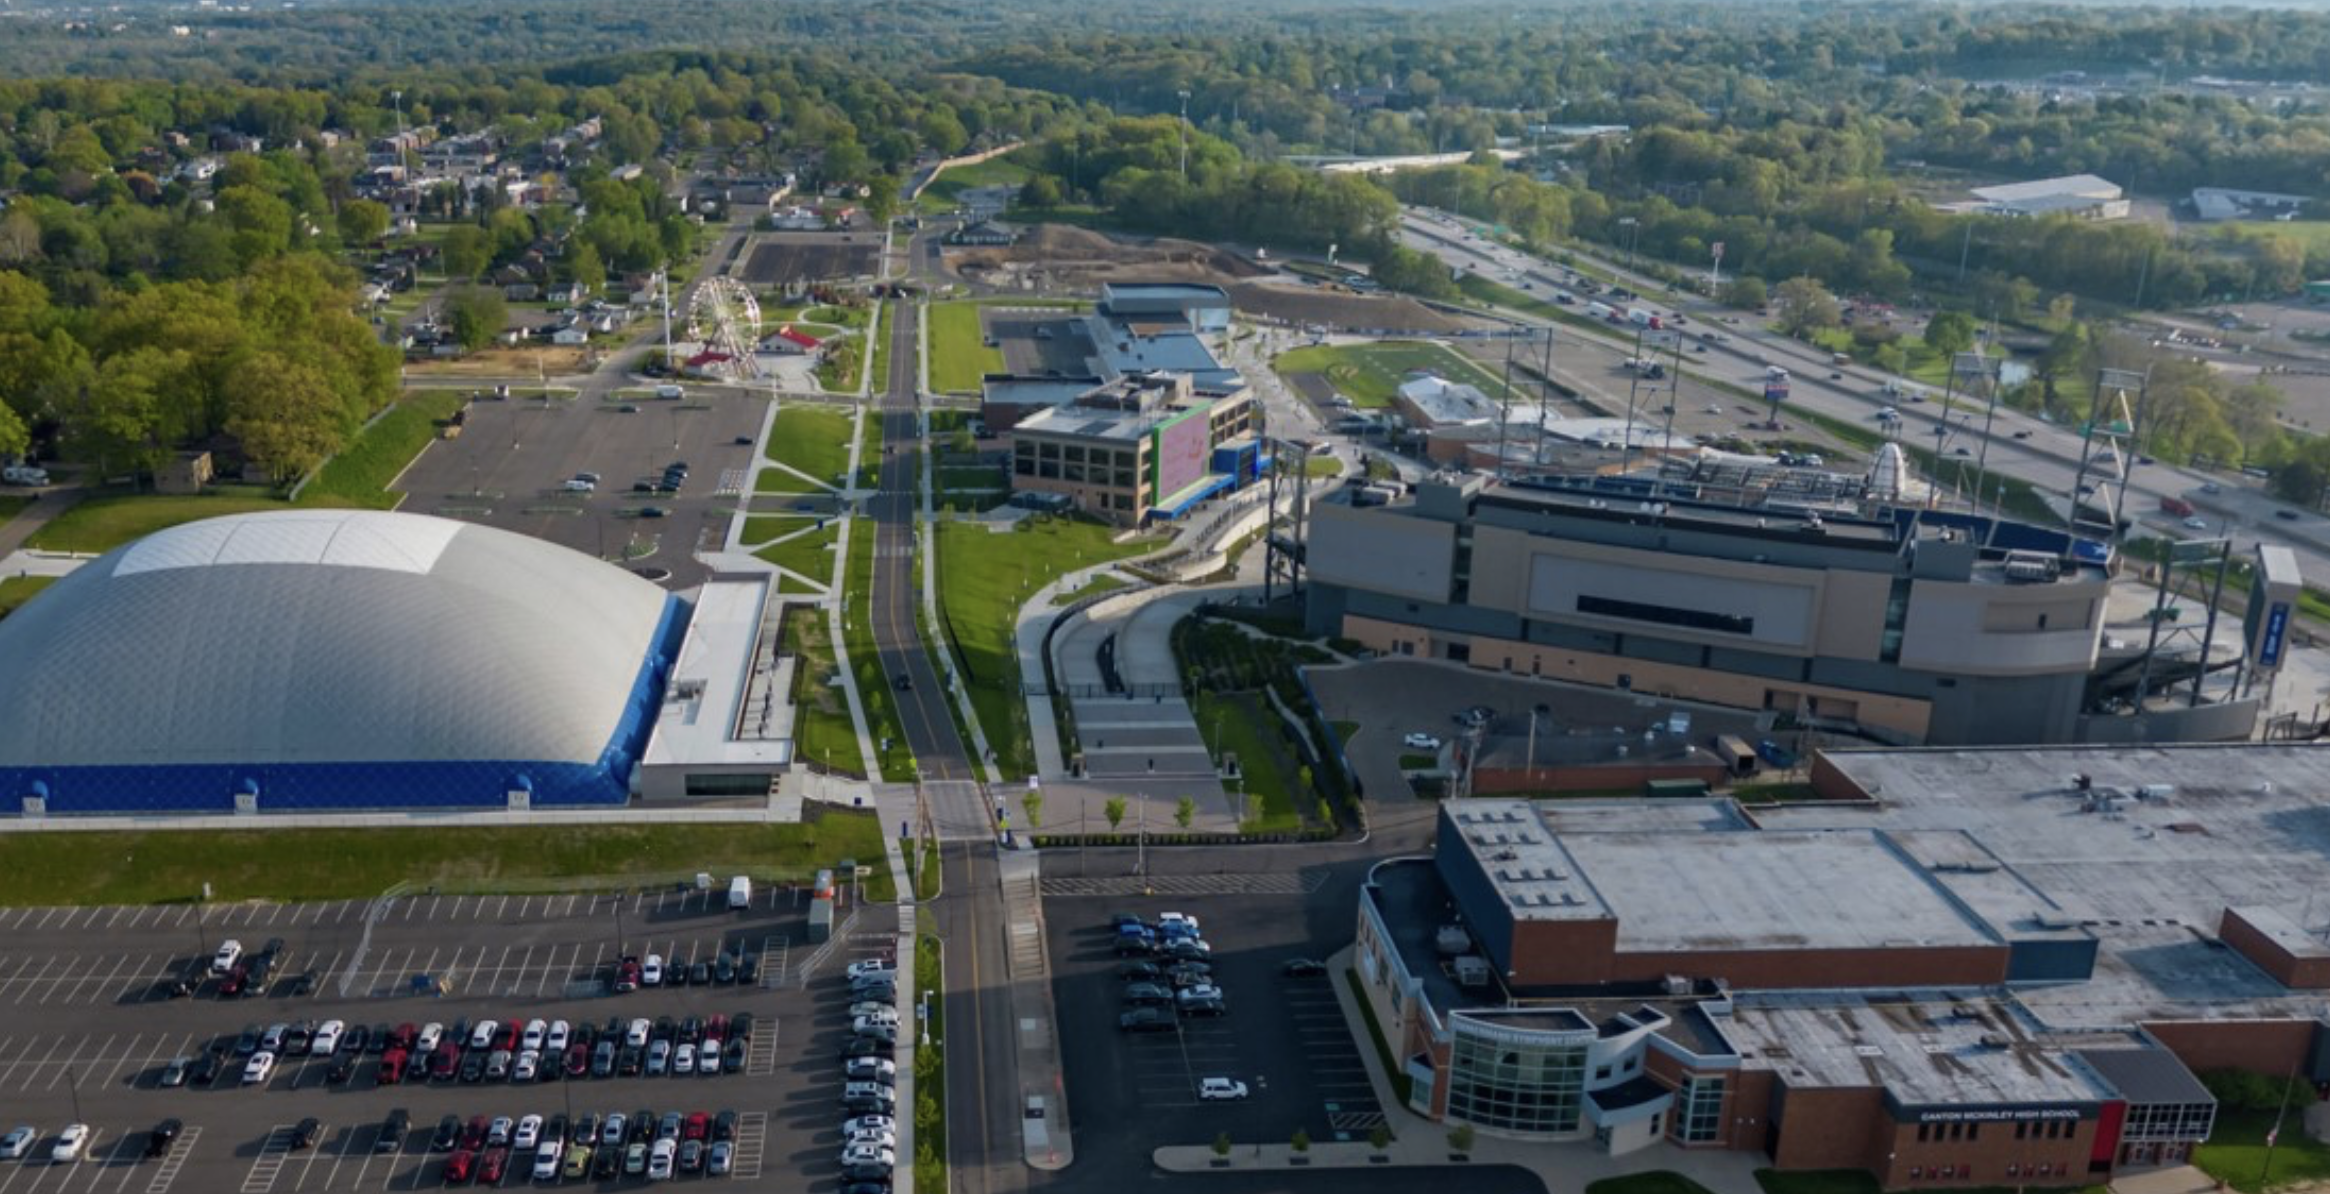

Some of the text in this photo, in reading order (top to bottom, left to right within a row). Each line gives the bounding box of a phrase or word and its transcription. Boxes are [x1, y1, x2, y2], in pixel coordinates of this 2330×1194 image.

[1921, 1111, 1962, 1121] CANTON
[2015, 1110, 2039, 1119] HIGH
[2041, 1109, 2079, 1118] SCHOOL
